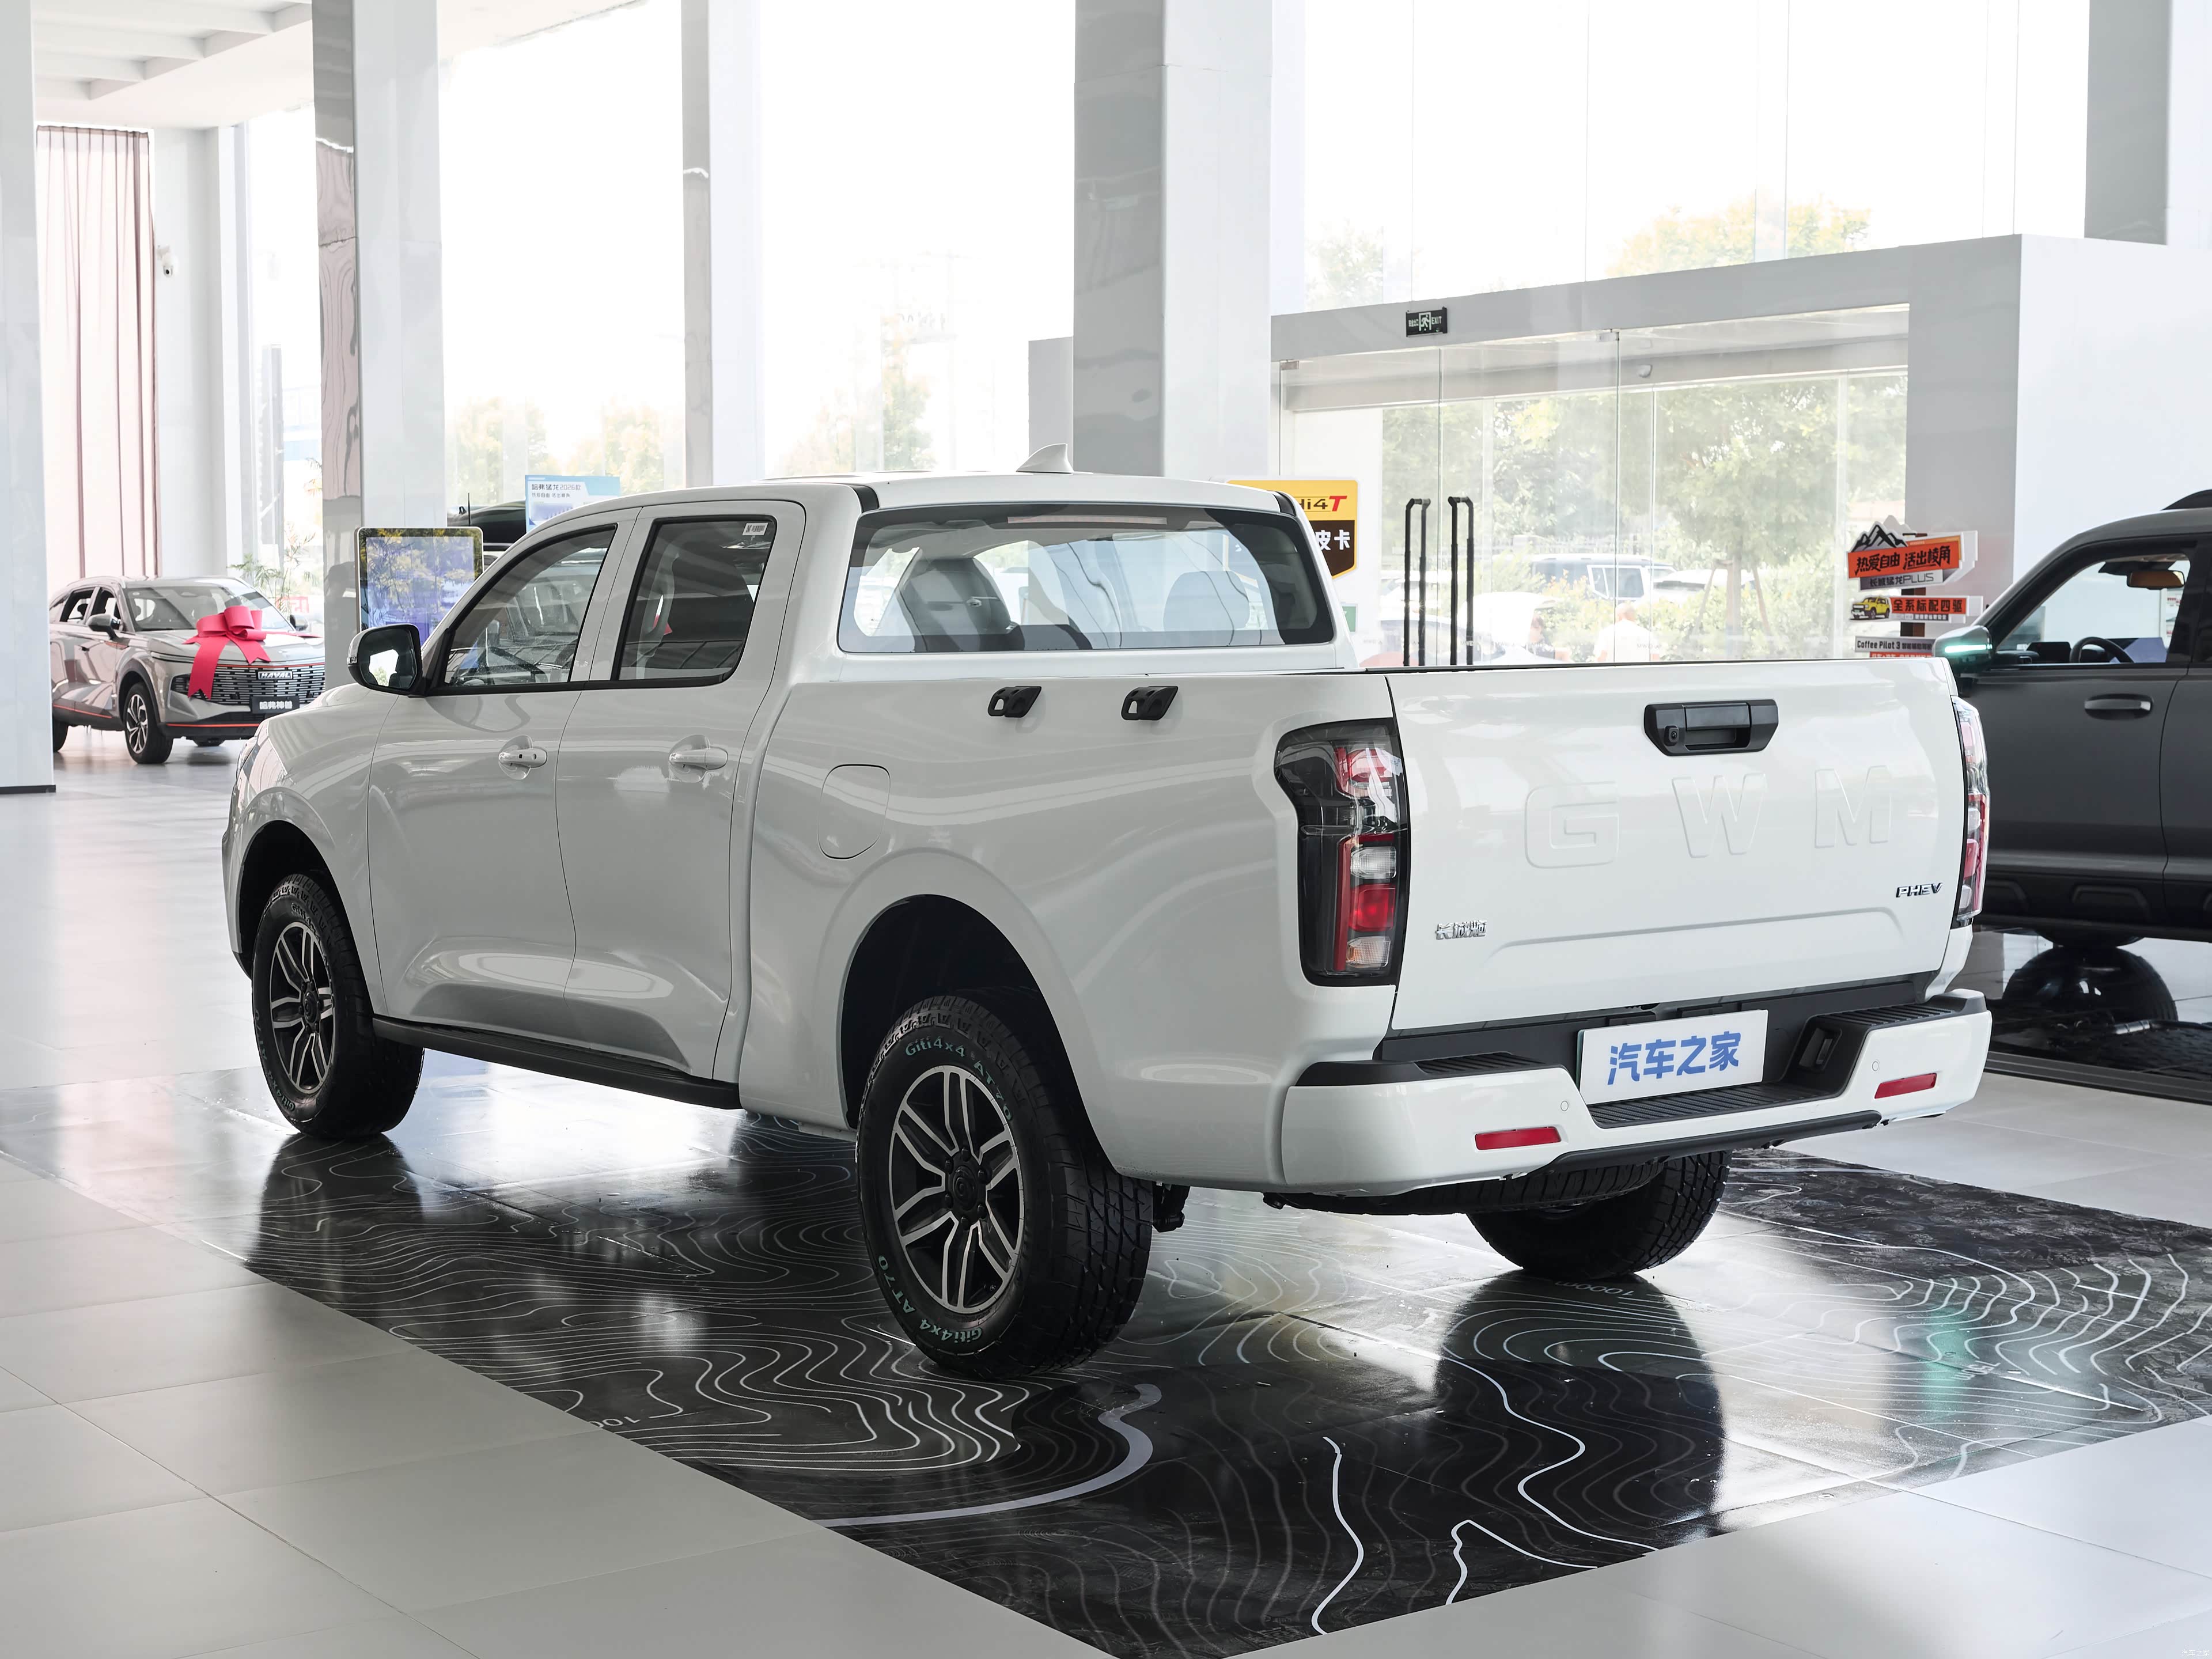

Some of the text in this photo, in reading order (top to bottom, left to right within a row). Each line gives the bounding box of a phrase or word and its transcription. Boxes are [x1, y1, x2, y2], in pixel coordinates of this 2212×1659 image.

[1431, 316, 1442, 325] EXIT
[1854, 546, 1950, 575] 热爱自由 活出棱角
[1893, 599, 1963, 612] 全系标配四驱
[1857, 640, 1878, 649] Coffee
[1879, 641, 1895, 649] Pilot
[1896, 641, 1900, 649] 3
[1524, 766, 1892, 869] GWM
[1896, 882, 1943, 898] PHEV
[1435, 920, 1487, 940] 长城炮
[1607, 1031, 1741, 1085] 汽车之家
